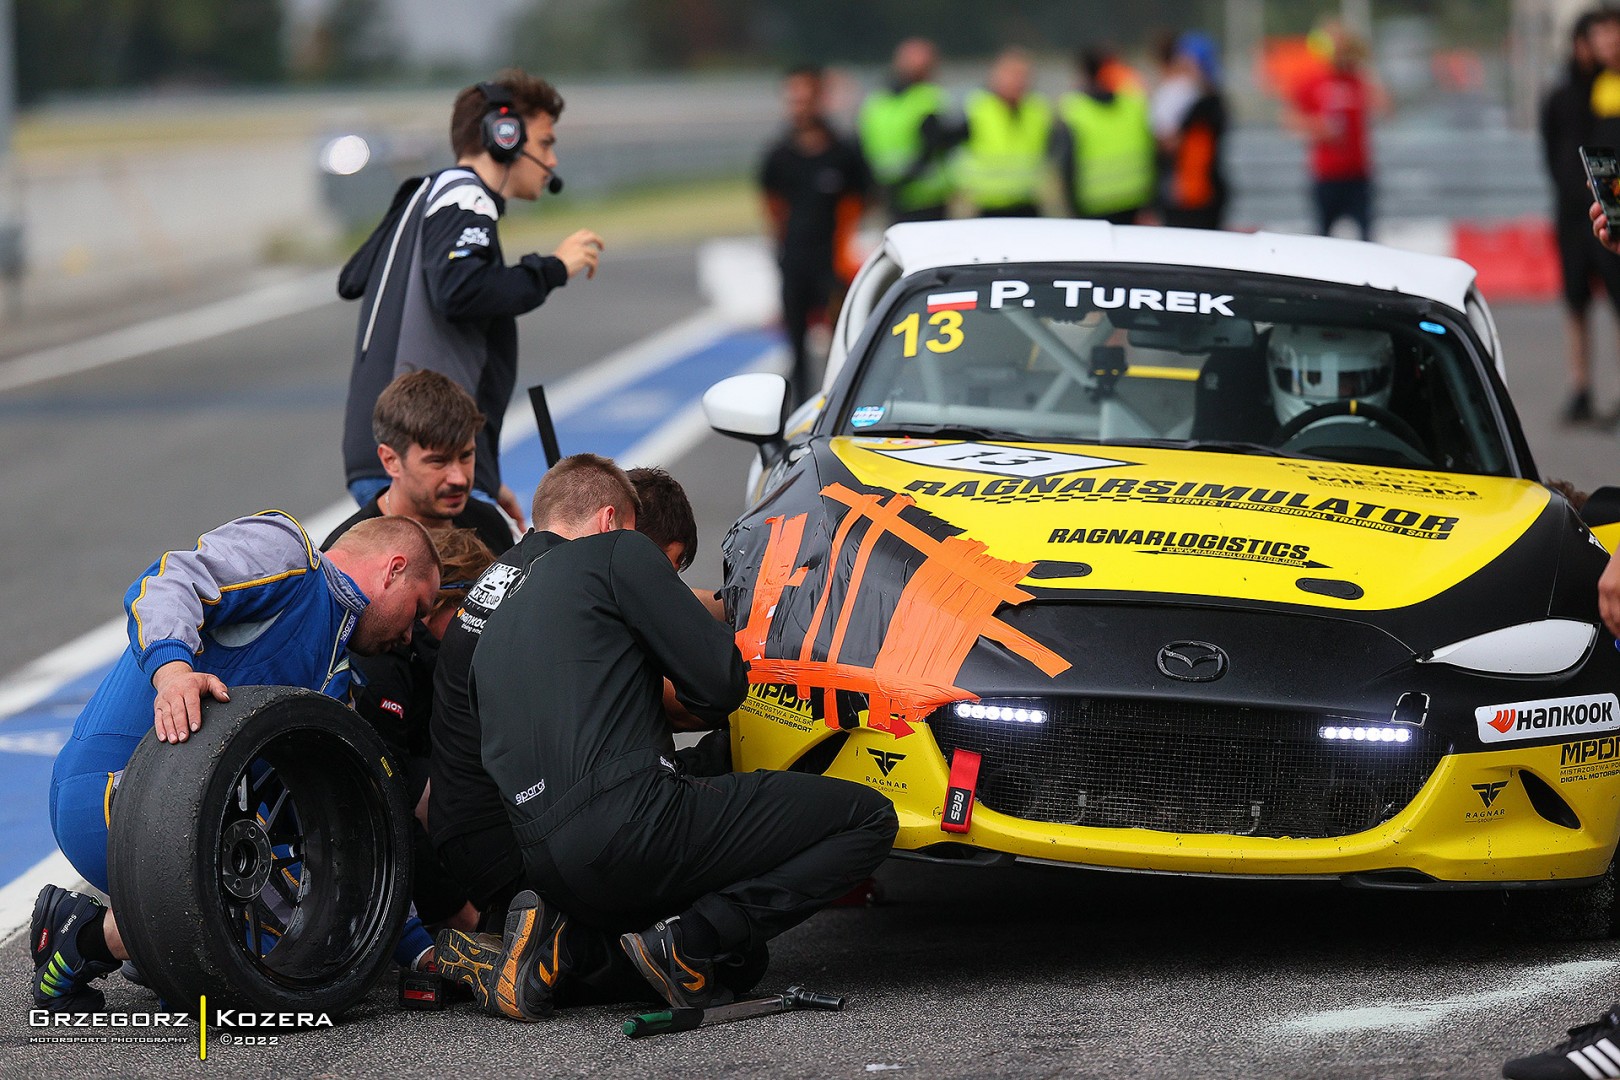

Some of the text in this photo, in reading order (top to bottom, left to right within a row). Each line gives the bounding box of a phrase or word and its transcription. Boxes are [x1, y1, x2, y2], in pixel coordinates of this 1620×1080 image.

[990, 280, 1235, 316] P. TUREK
[892, 310, 964, 357] 13
[948, 451, 1053, 467] 13
[904, 478, 1460, 532] RAGNARSIMULATOR
[1166, 497, 1440, 539] EVENTS PROFESSIONAL TRAINING SALE
[1047, 528, 1310, 560] RAGNARLOGISTICS
[740, 704, 813, 733] DIGITAL MOTORSPORT
[1561, 736, 1620, 765] MPD
[865, 776, 908, 790] RAGNAR
[1560, 765, 1609, 776] MISTRZOSTWA
[1561, 775, 1587, 784] DIGITAL
[1465, 808, 1505, 819] RAGNAR
